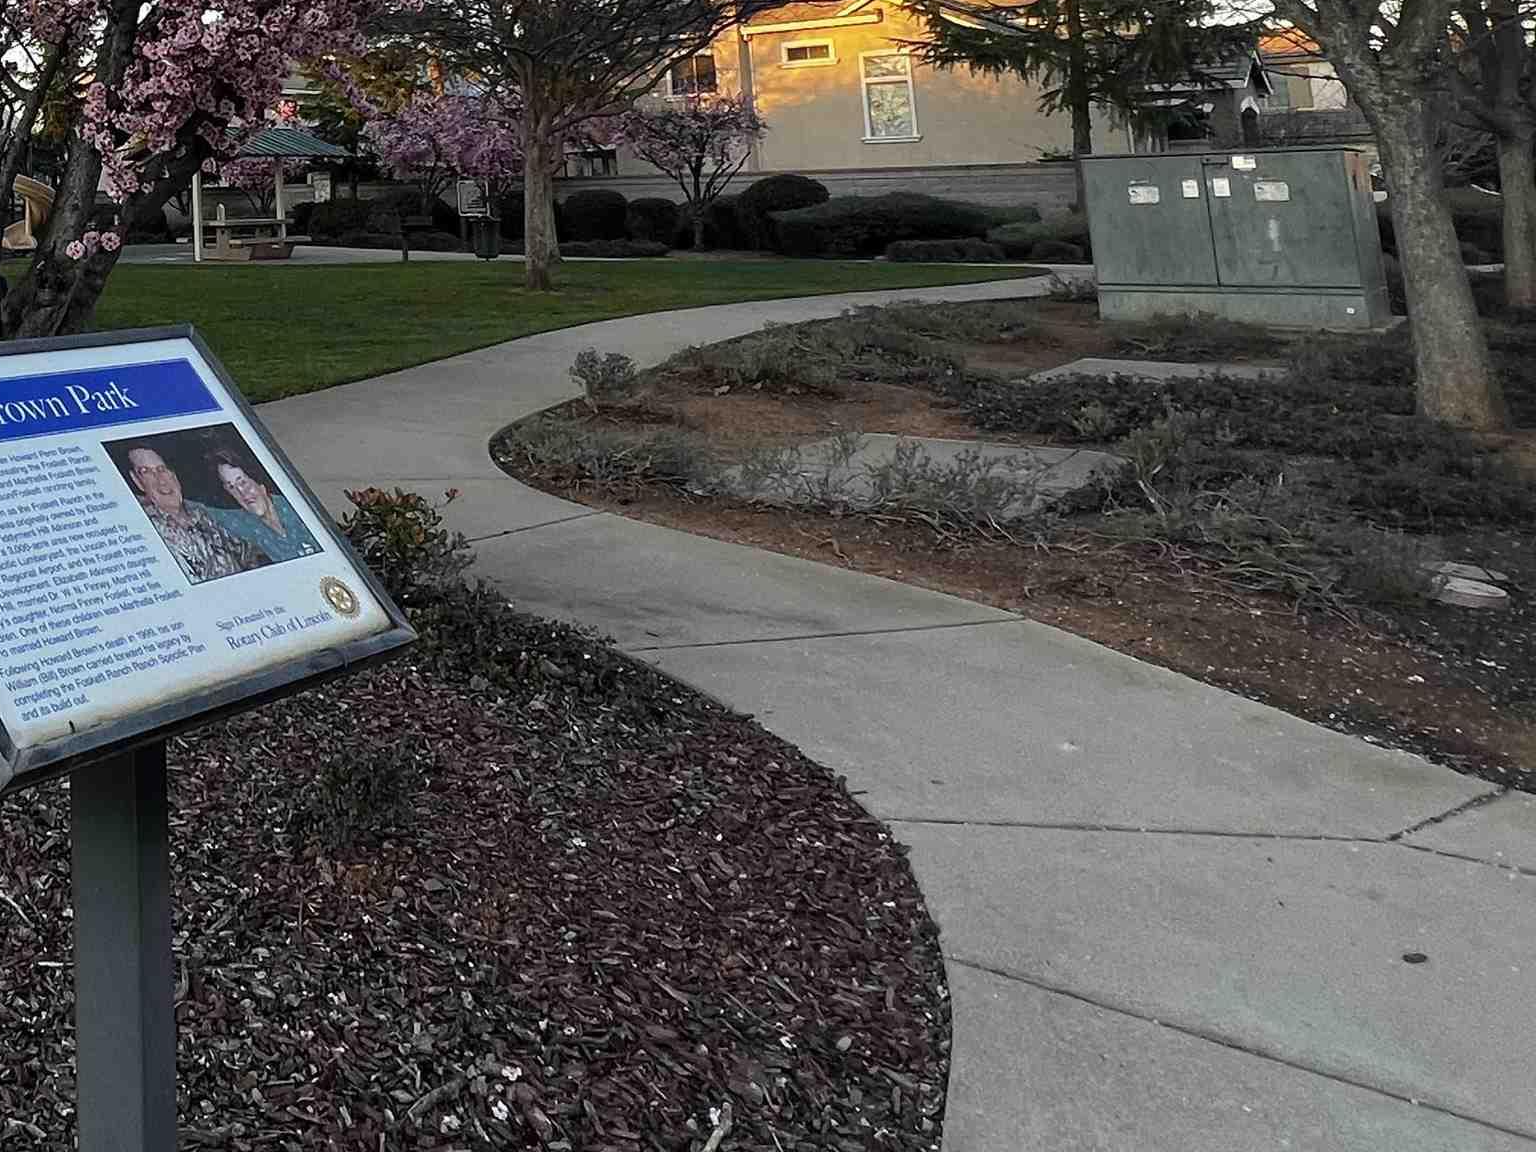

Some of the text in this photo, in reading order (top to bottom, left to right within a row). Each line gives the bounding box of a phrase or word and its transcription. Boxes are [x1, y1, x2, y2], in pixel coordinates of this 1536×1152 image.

[65, 381, 140, 414] Park
[0, 568, 37, 583] Regional
[17, 593, 49, 608] married
[41, 630, 75, 647] Howard
[226, 610, 331, 649] Rotary Club of Lincoln
[5, 678, 39, 692] William
[57, 664, 86, 678] Brown
[86, 654, 114, 670] carried
[112, 646, 144, 661] forward
[142, 642, 157, 653] his
[155, 637, 181, 649] legacy
[179, 633, 192, 643] by
[39, 650, 73, 667] Howard
[105, 636, 128, 649] death
[126, 634, 137, 642] in
[14, 688, 62, 707] completing
[59, 683, 76, 693] the
[105, 664, 133, 680] Ranch
[131, 657, 159, 671] Ranch
[158, 649, 189, 664] Specific
[22, 708, 40, 722] and
[38, 706, 52, 716] its
[50, 698, 73, 712] build
